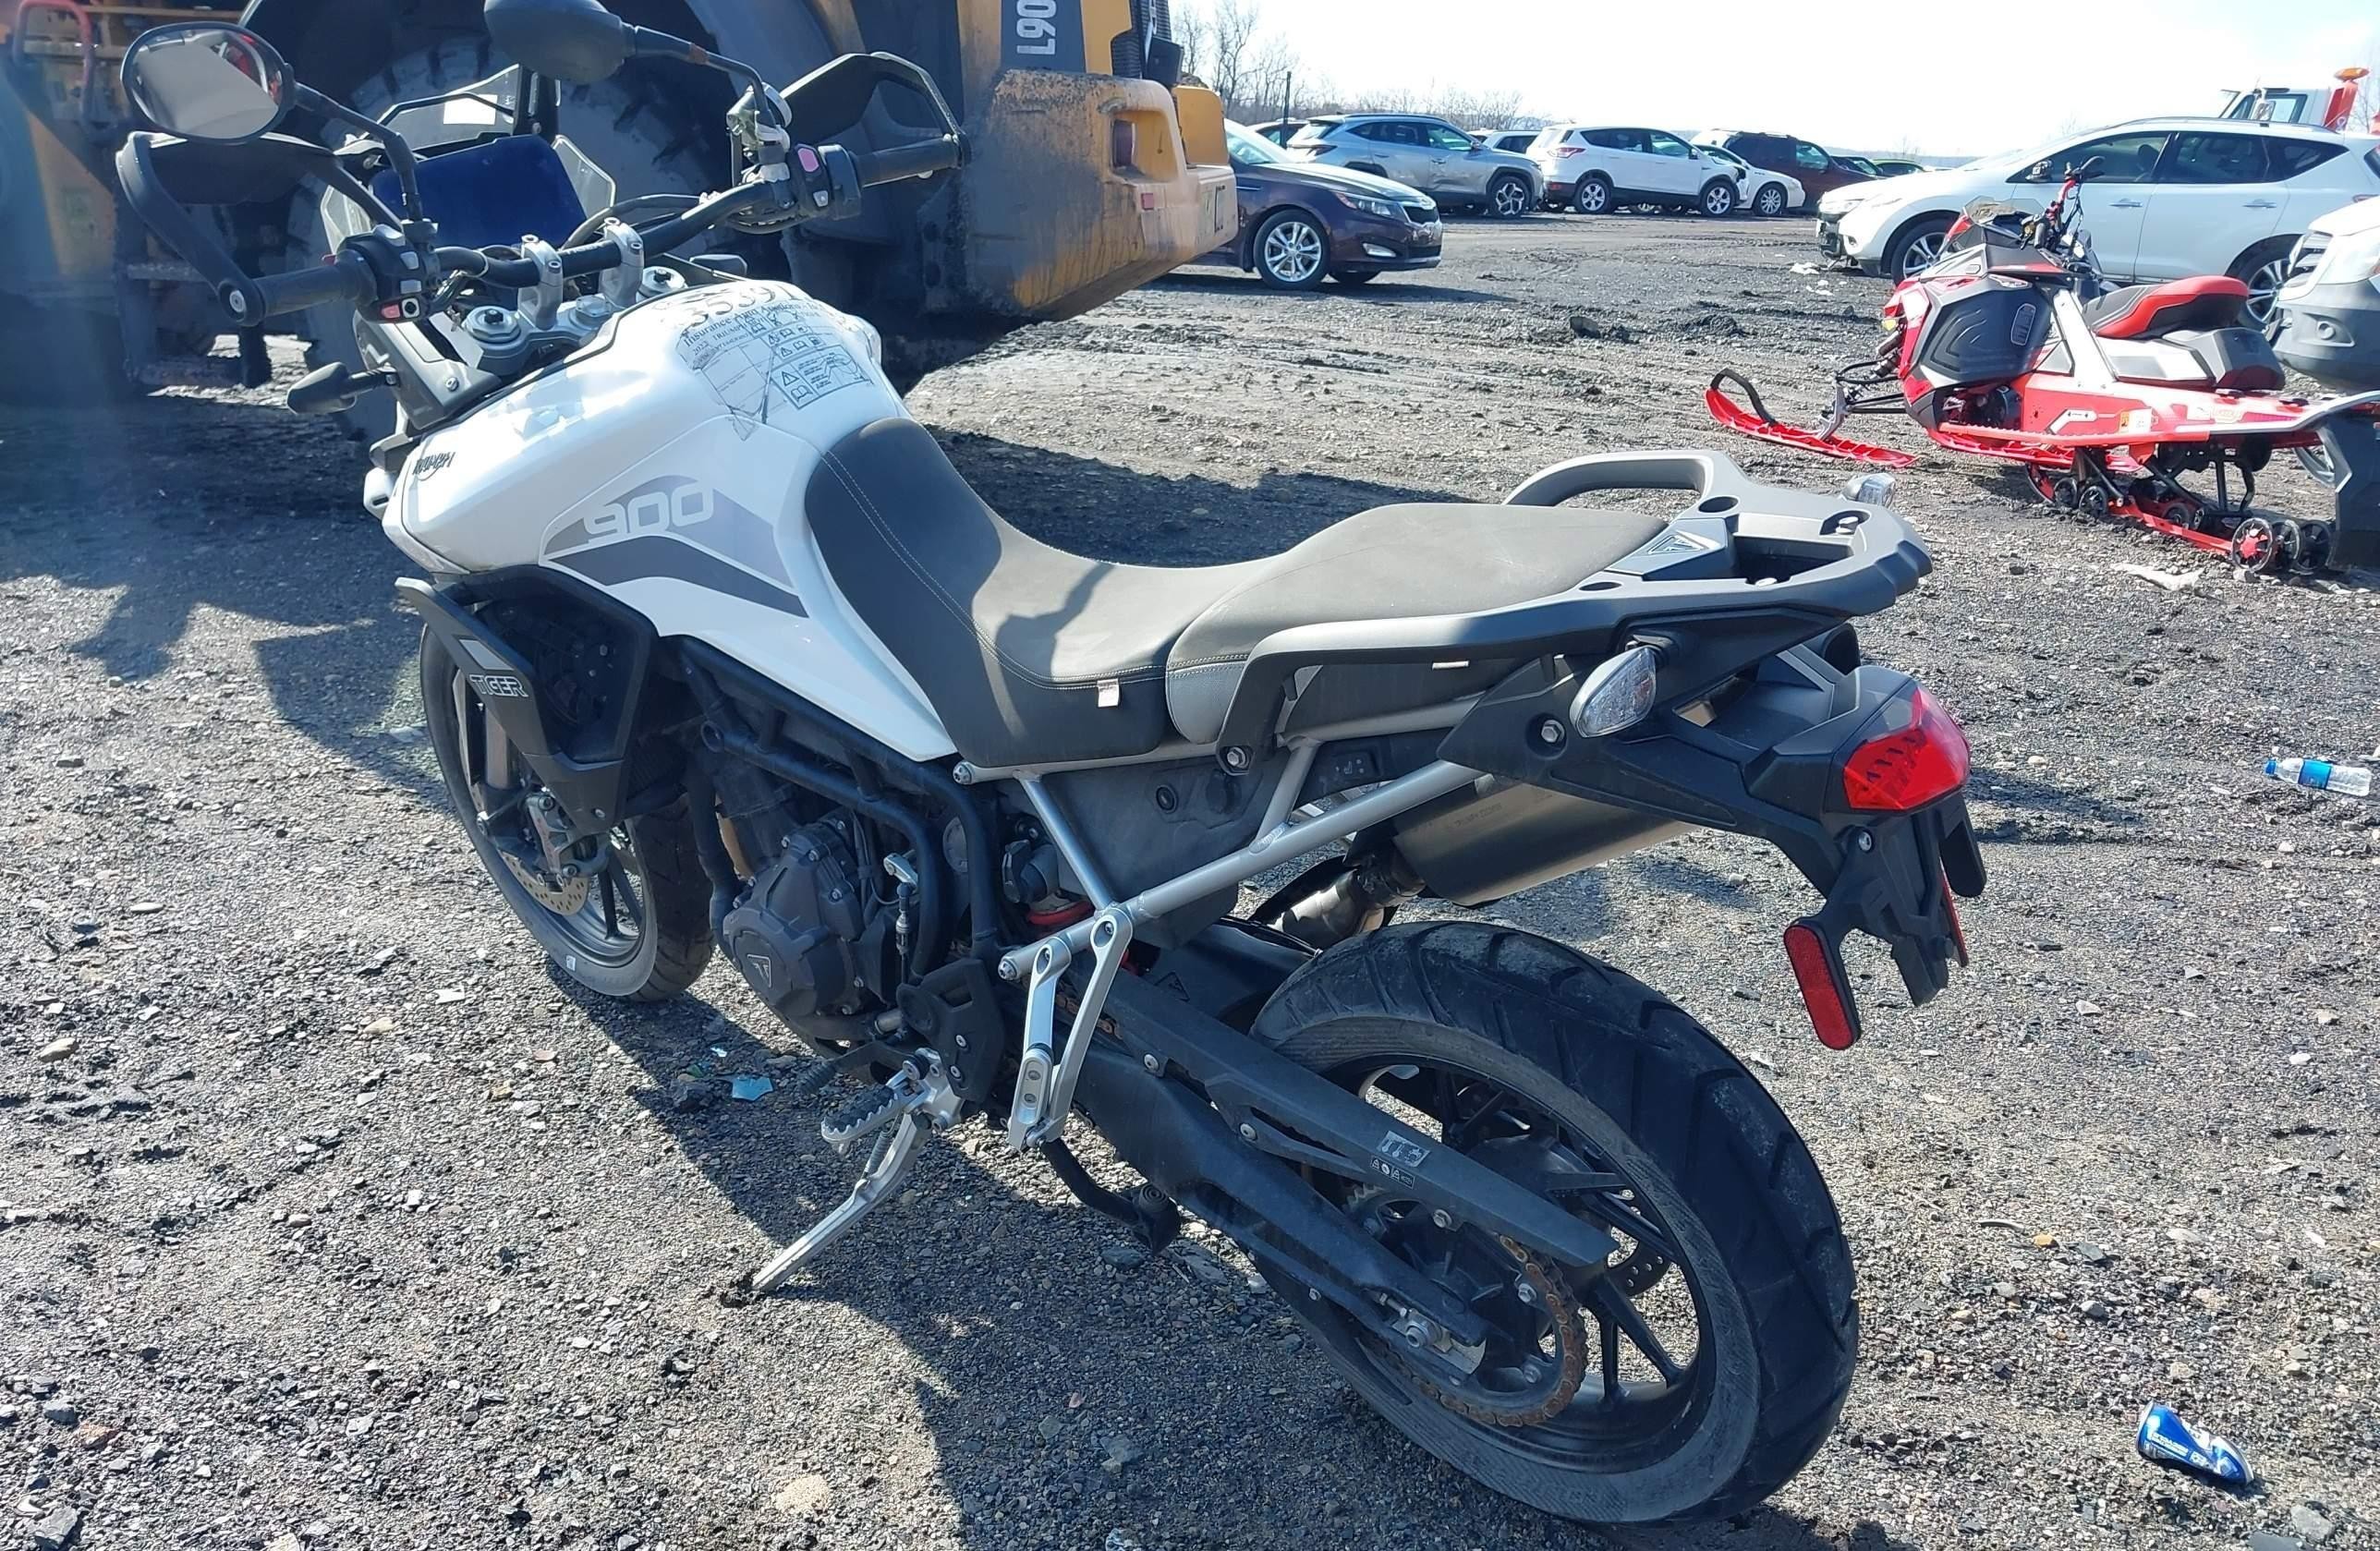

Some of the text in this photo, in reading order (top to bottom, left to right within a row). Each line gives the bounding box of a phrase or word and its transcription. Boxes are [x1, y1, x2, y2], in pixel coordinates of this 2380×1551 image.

[1016, 0, 1057, 55] L90
[684, 318, 733, 347] Insurance
[584, 483, 714, 541] 900
[469, 674, 529, 697] TIGER
